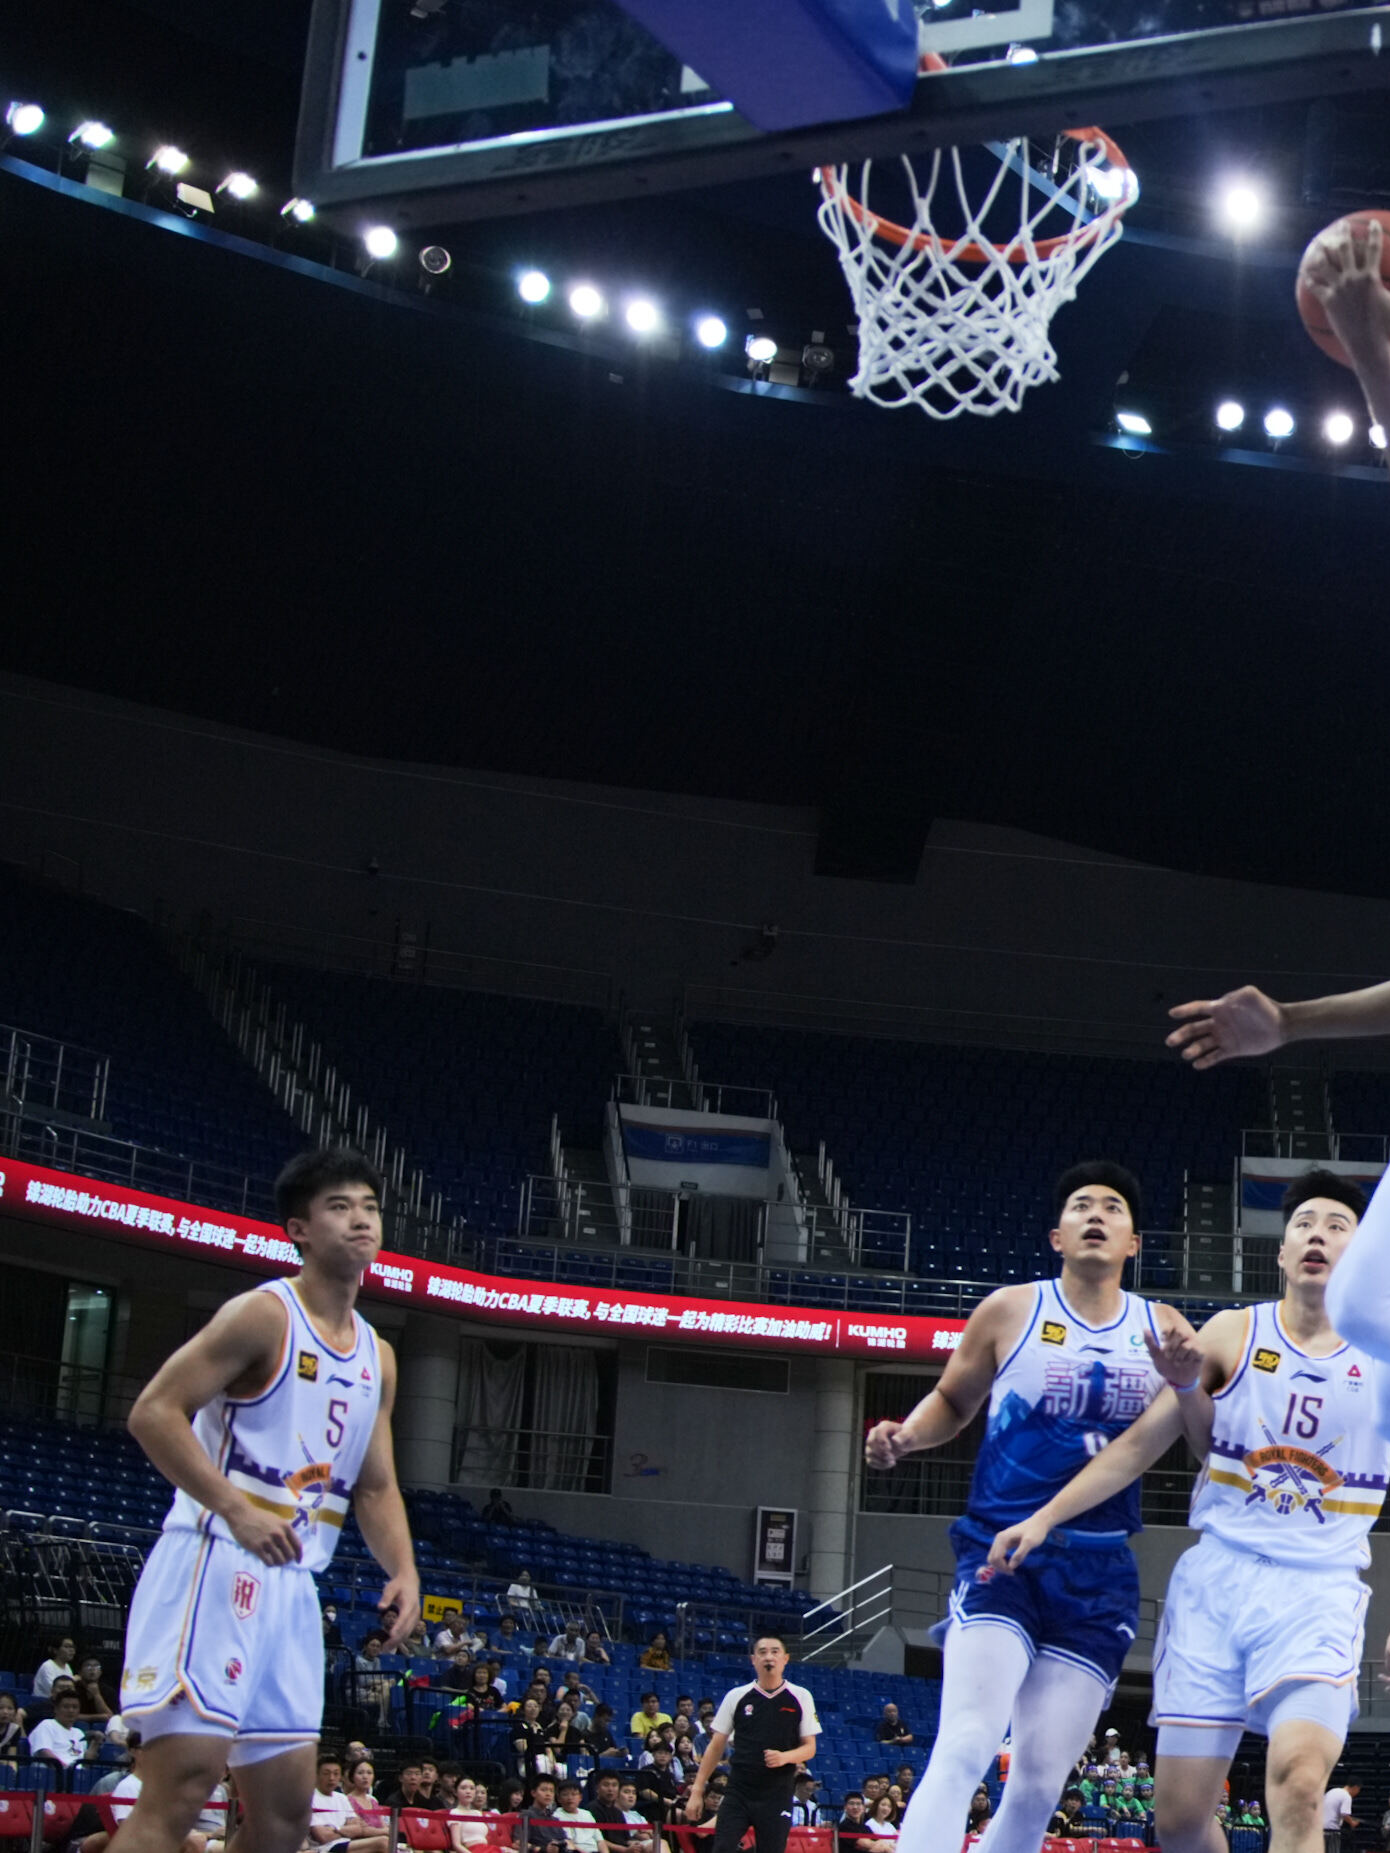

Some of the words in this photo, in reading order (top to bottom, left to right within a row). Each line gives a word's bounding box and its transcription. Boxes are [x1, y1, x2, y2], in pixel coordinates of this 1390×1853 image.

[369, 1262, 414, 1283] KUMHO
[848, 1324, 907, 1341] KUMHO
[326, 1399, 348, 1449] 5
[1282, 1393, 1324, 1440] 15
